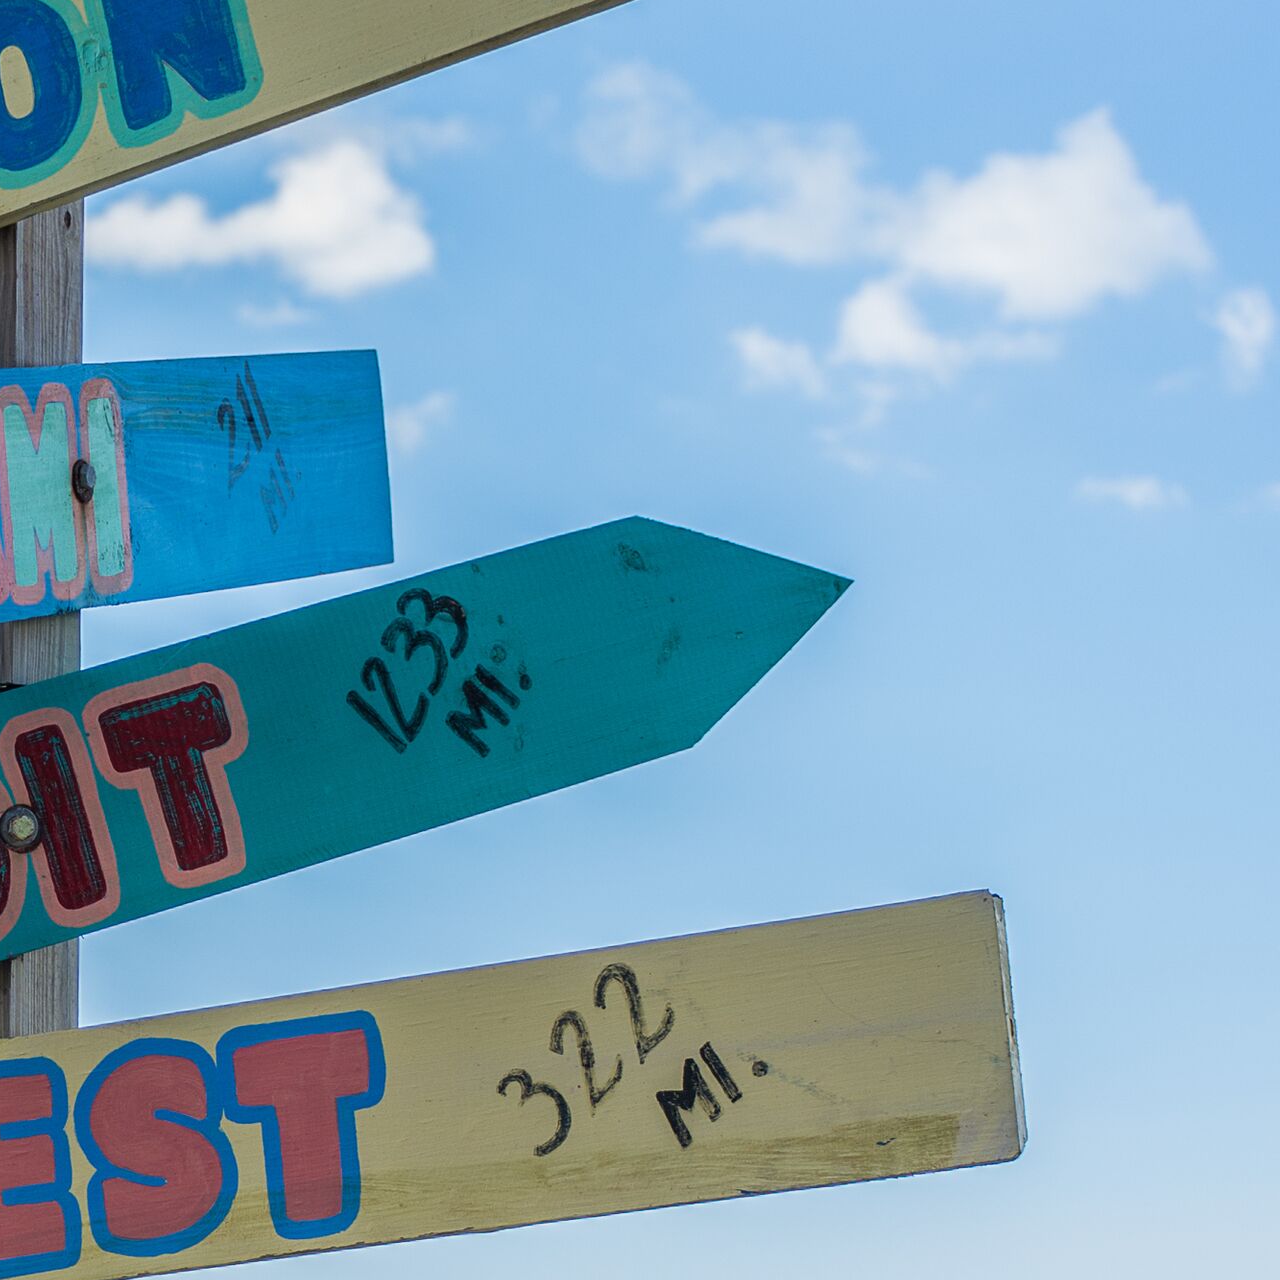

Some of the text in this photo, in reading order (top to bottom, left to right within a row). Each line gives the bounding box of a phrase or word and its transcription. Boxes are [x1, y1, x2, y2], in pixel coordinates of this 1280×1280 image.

[346, 587, 468, 754] 1233
[497, 963, 674, 1157] 322
[656, 1041, 769, 1149] MI.
